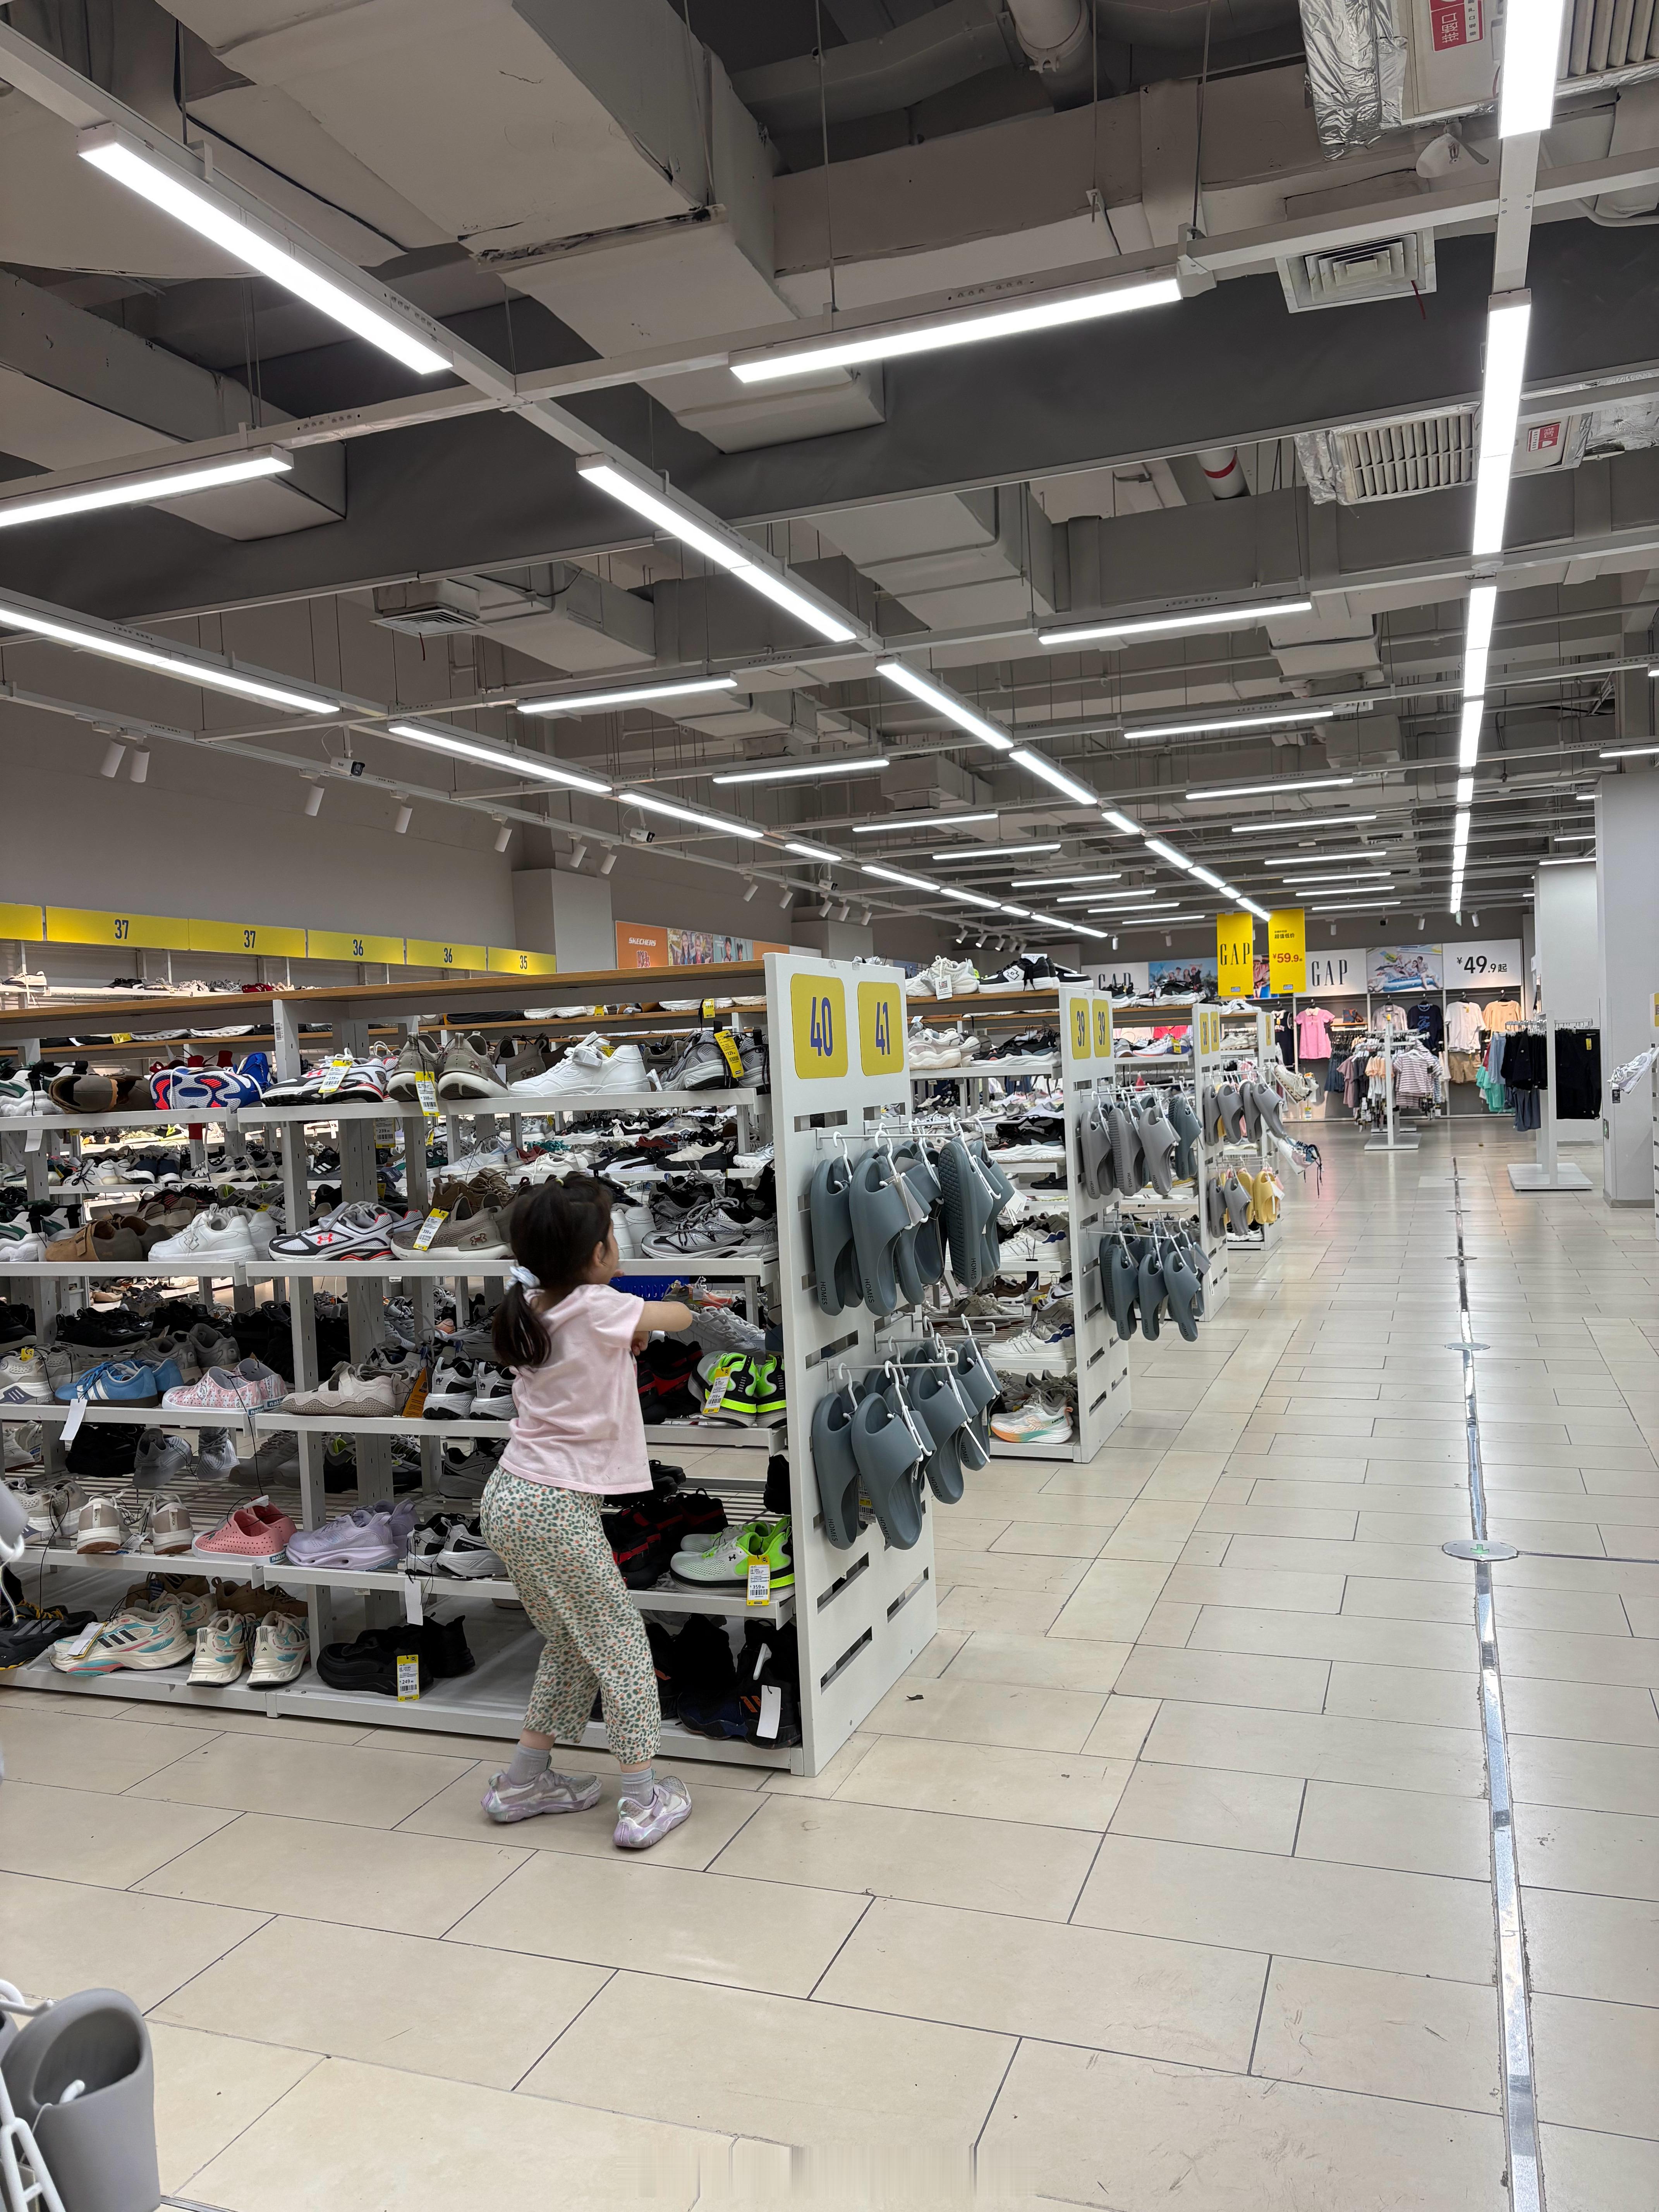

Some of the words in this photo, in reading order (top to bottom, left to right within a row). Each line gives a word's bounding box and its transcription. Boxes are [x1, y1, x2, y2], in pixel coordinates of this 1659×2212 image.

[114, 919, 129, 940] 37
[244, 930, 256, 948] 37
[353, 939, 364, 957] 36
[629, 938, 656, 946] SKECHERS
[444, 947, 453, 963] 36
[519, 955, 528, 970] 35
[1220, 943, 1250, 966] GAP
[1312, 959, 1348, 987] GAP
[811, 997, 833, 1056] 40
[876, 1002, 890, 1055] 41
[1077, 1010, 1084, 1047] 39
[1098, 1011, 1105, 1045] 39
[864, 1278, 875, 1304] HOMES
[960, 1442, 970, 1463] HOMES
[931, 1477, 942, 1498] HOMES
[828, 1519, 838, 1542] HOMES
[879, 1517, 891, 1540] HOMES
